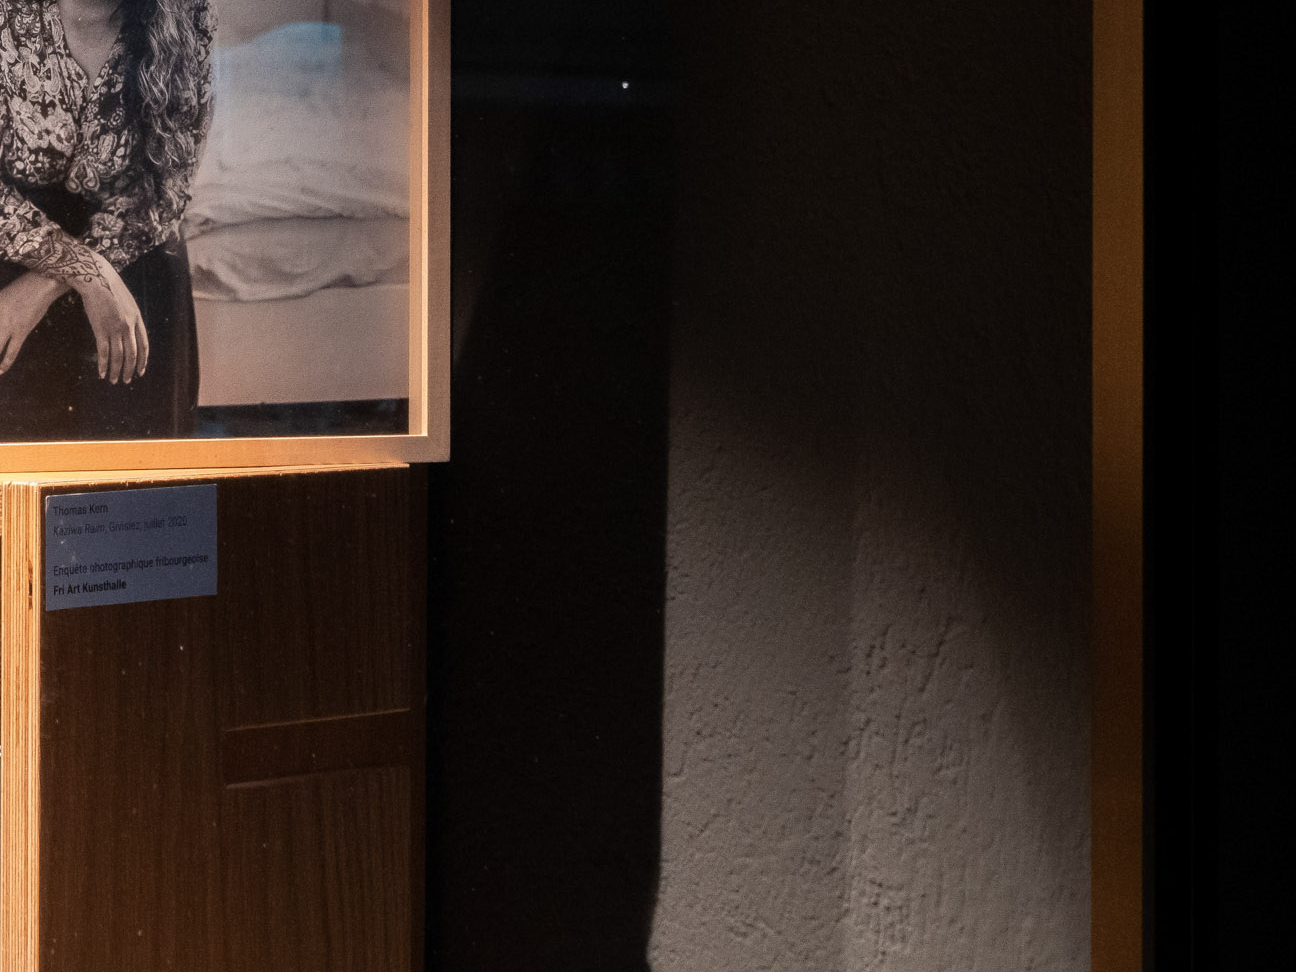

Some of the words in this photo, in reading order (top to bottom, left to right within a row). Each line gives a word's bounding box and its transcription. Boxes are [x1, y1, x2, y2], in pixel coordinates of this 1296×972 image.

[53, 505, 87, 517] Thomas
[89, 503, 108, 515] Kern
[168, 515, 188, 529] 2020
[54, 563, 87, 578] Enquête
[90, 557, 153, 575] photographique
[156, 553, 209, 569] fribourgeoise
[54, 585, 65, 596] Fri
[67, 583, 81, 594] Art
[83, 579, 127, 593] Kunsthalle
